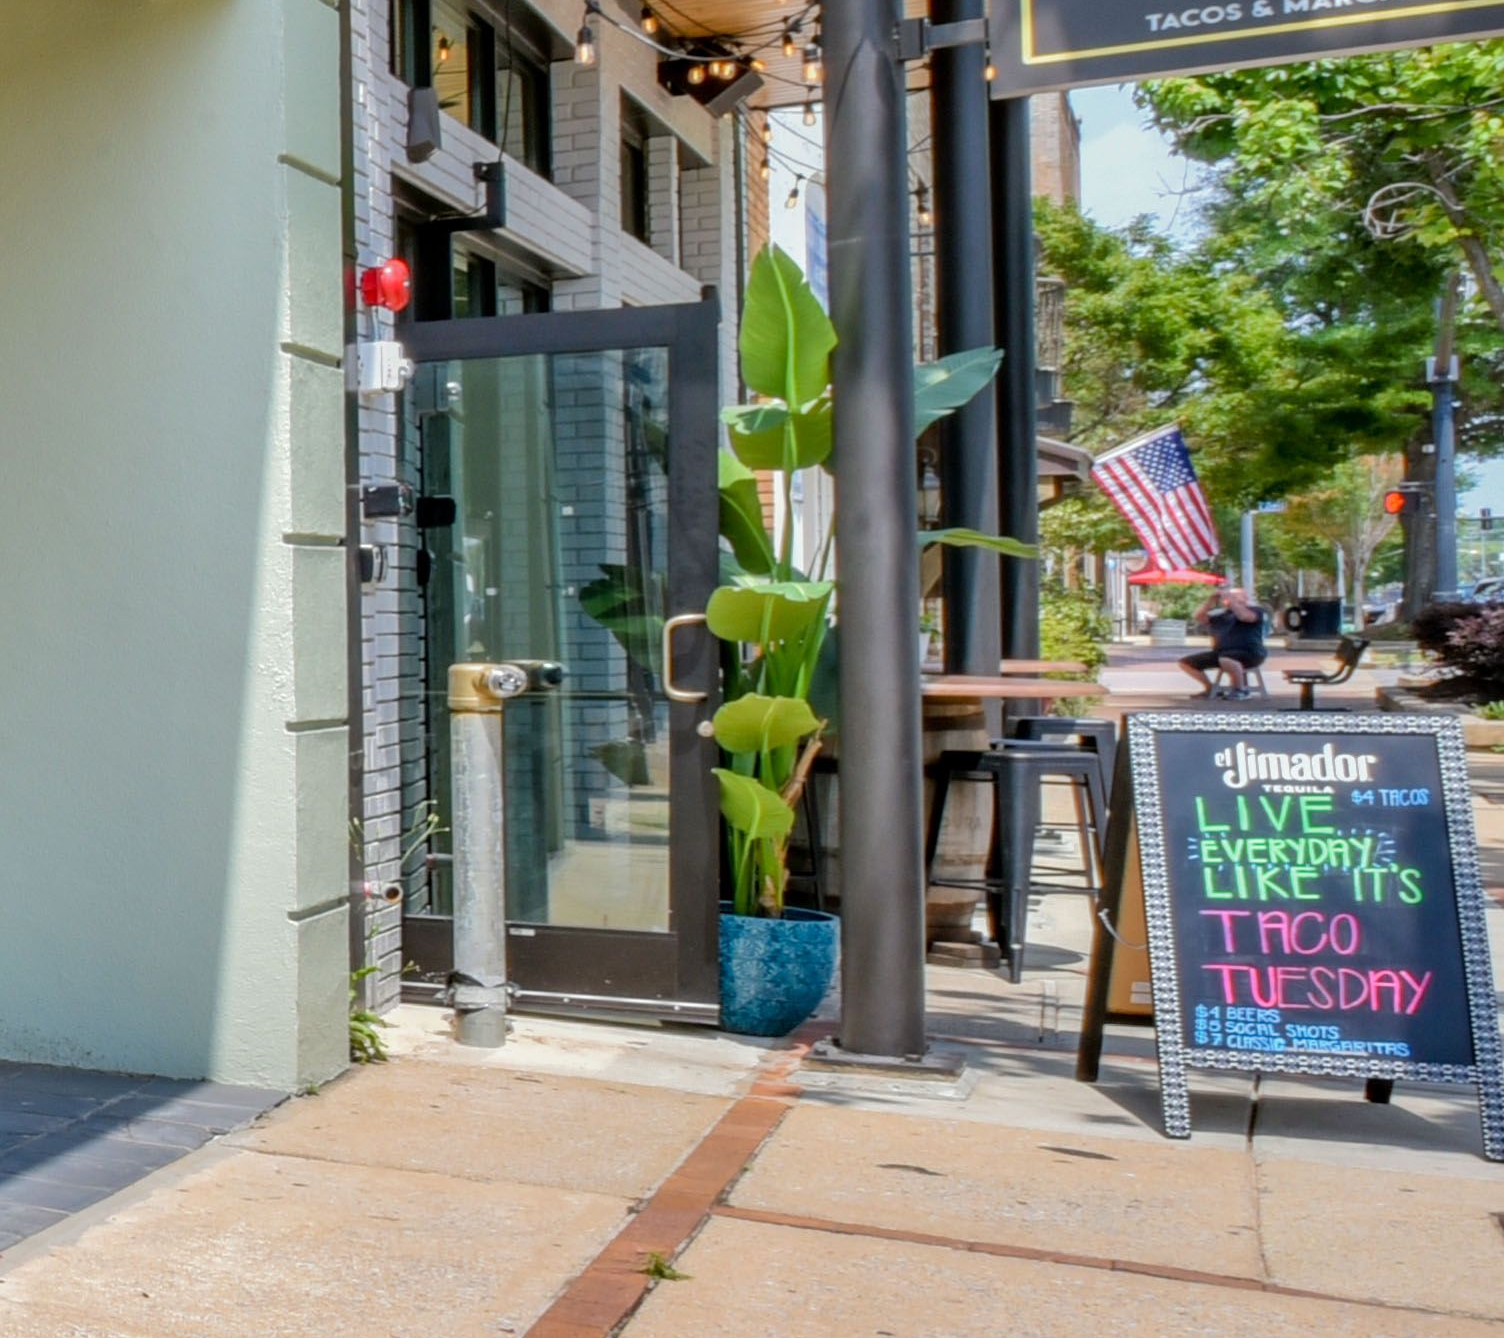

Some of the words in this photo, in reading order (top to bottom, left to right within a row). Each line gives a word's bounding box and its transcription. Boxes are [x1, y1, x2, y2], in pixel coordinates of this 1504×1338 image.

[1145, 2, 1243, 33] TACOS
[1222, 741, 1377, 788] Jimador
[1262, 784, 1335, 794] TEQUILA
[1350, 788, 1375, 805] $4
[1378, 788, 1430, 807] TACOS
[1195, 795, 1336, 834] LIVE
[1200, 836, 1372, 869] EVERYDAY
[1203, 865, 1322, 901] LIKE
[1353, 863, 1423, 903] IT'S
[1199, 910, 1360, 955] TACO
[1200, 964, 1432, 1015] TUESDAY
[1195, 1004, 1221, 1019] $4
[1226, 1007, 1281, 1023] BEERS
[1225, 1021, 1281, 1036] SOCAL
[1285, 1024, 1340, 1040] SHOTS
[1226, 1035, 1286, 1052] CLASSIC
[1292, 1038, 1411, 1057] MARGARITAS
